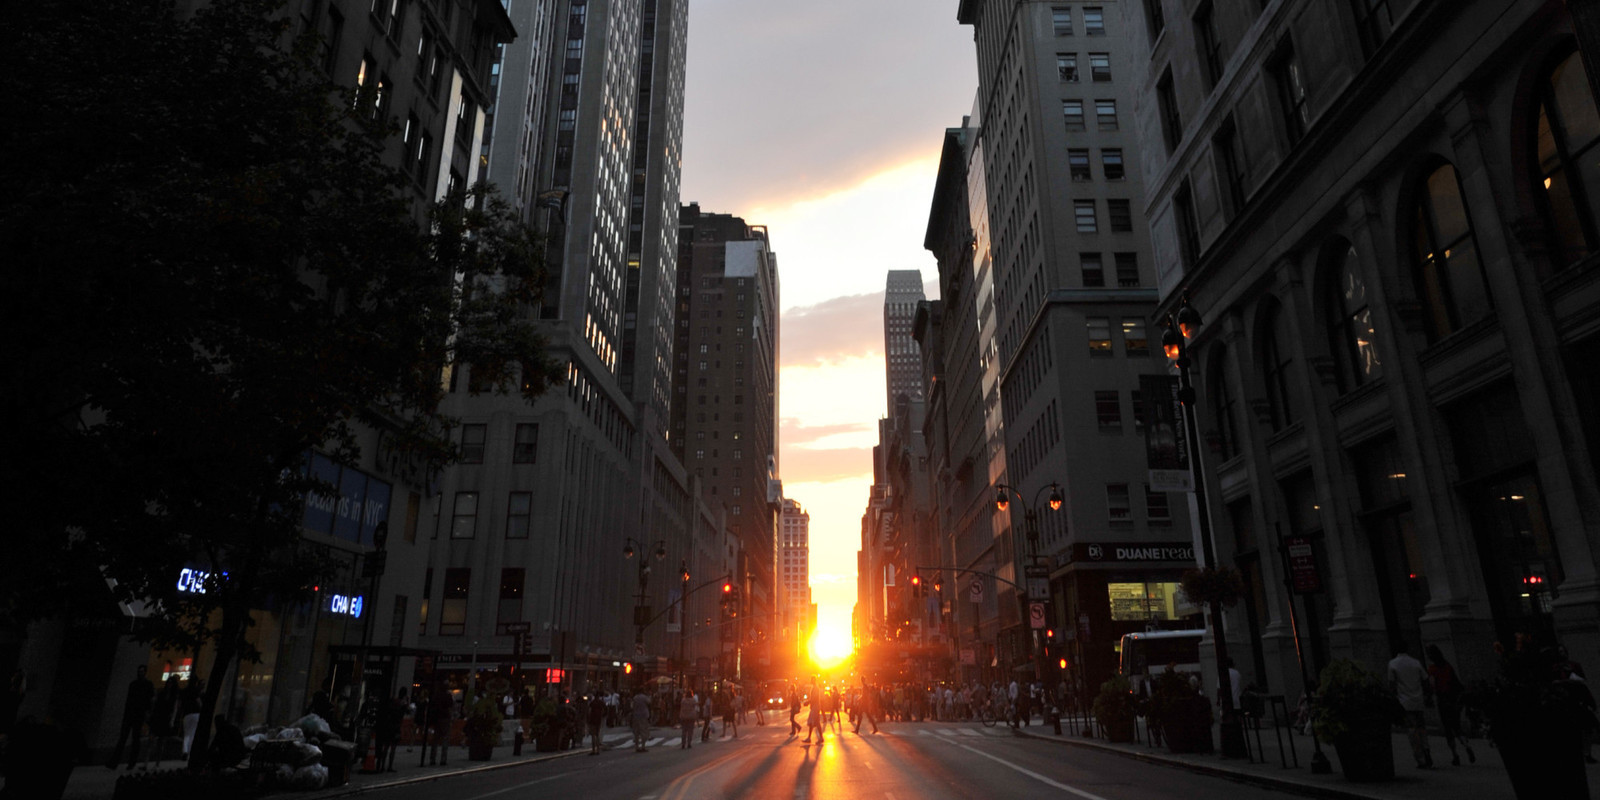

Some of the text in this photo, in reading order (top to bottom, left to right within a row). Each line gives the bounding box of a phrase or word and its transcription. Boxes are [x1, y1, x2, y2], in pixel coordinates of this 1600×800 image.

[351, 492, 361, 521] in
[363, 498, 383, 527] NYC
[331, 594, 357, 615] CHAE
